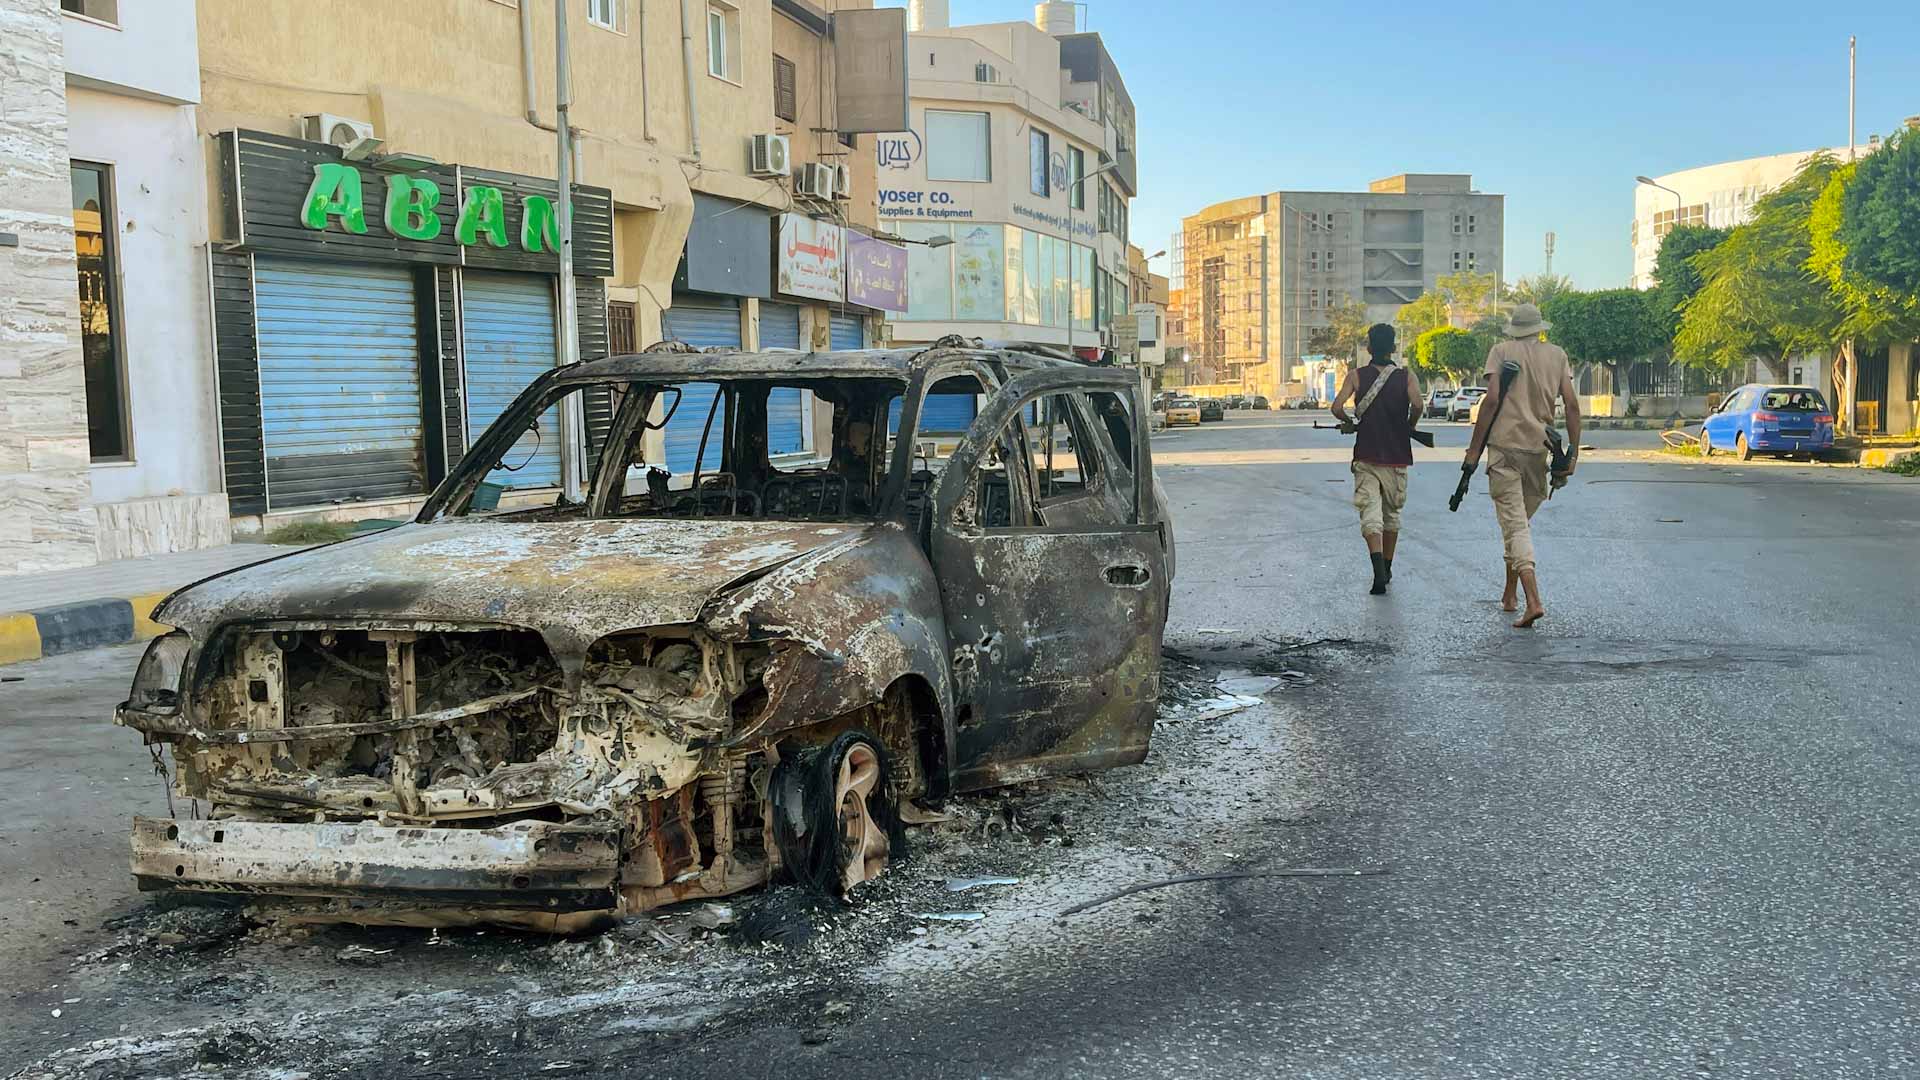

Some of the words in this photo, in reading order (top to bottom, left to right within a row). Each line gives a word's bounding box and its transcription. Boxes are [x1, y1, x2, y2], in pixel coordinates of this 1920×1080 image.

[878, 189, 924, 205] yoser
[930, 190, 955, 205] co.
[301, 163, 573, 253] ABAN
[878, 206, 914, 217] Supplies
[916, 206, 925, 217] &
[926, 207, 973, 218] Equipment
